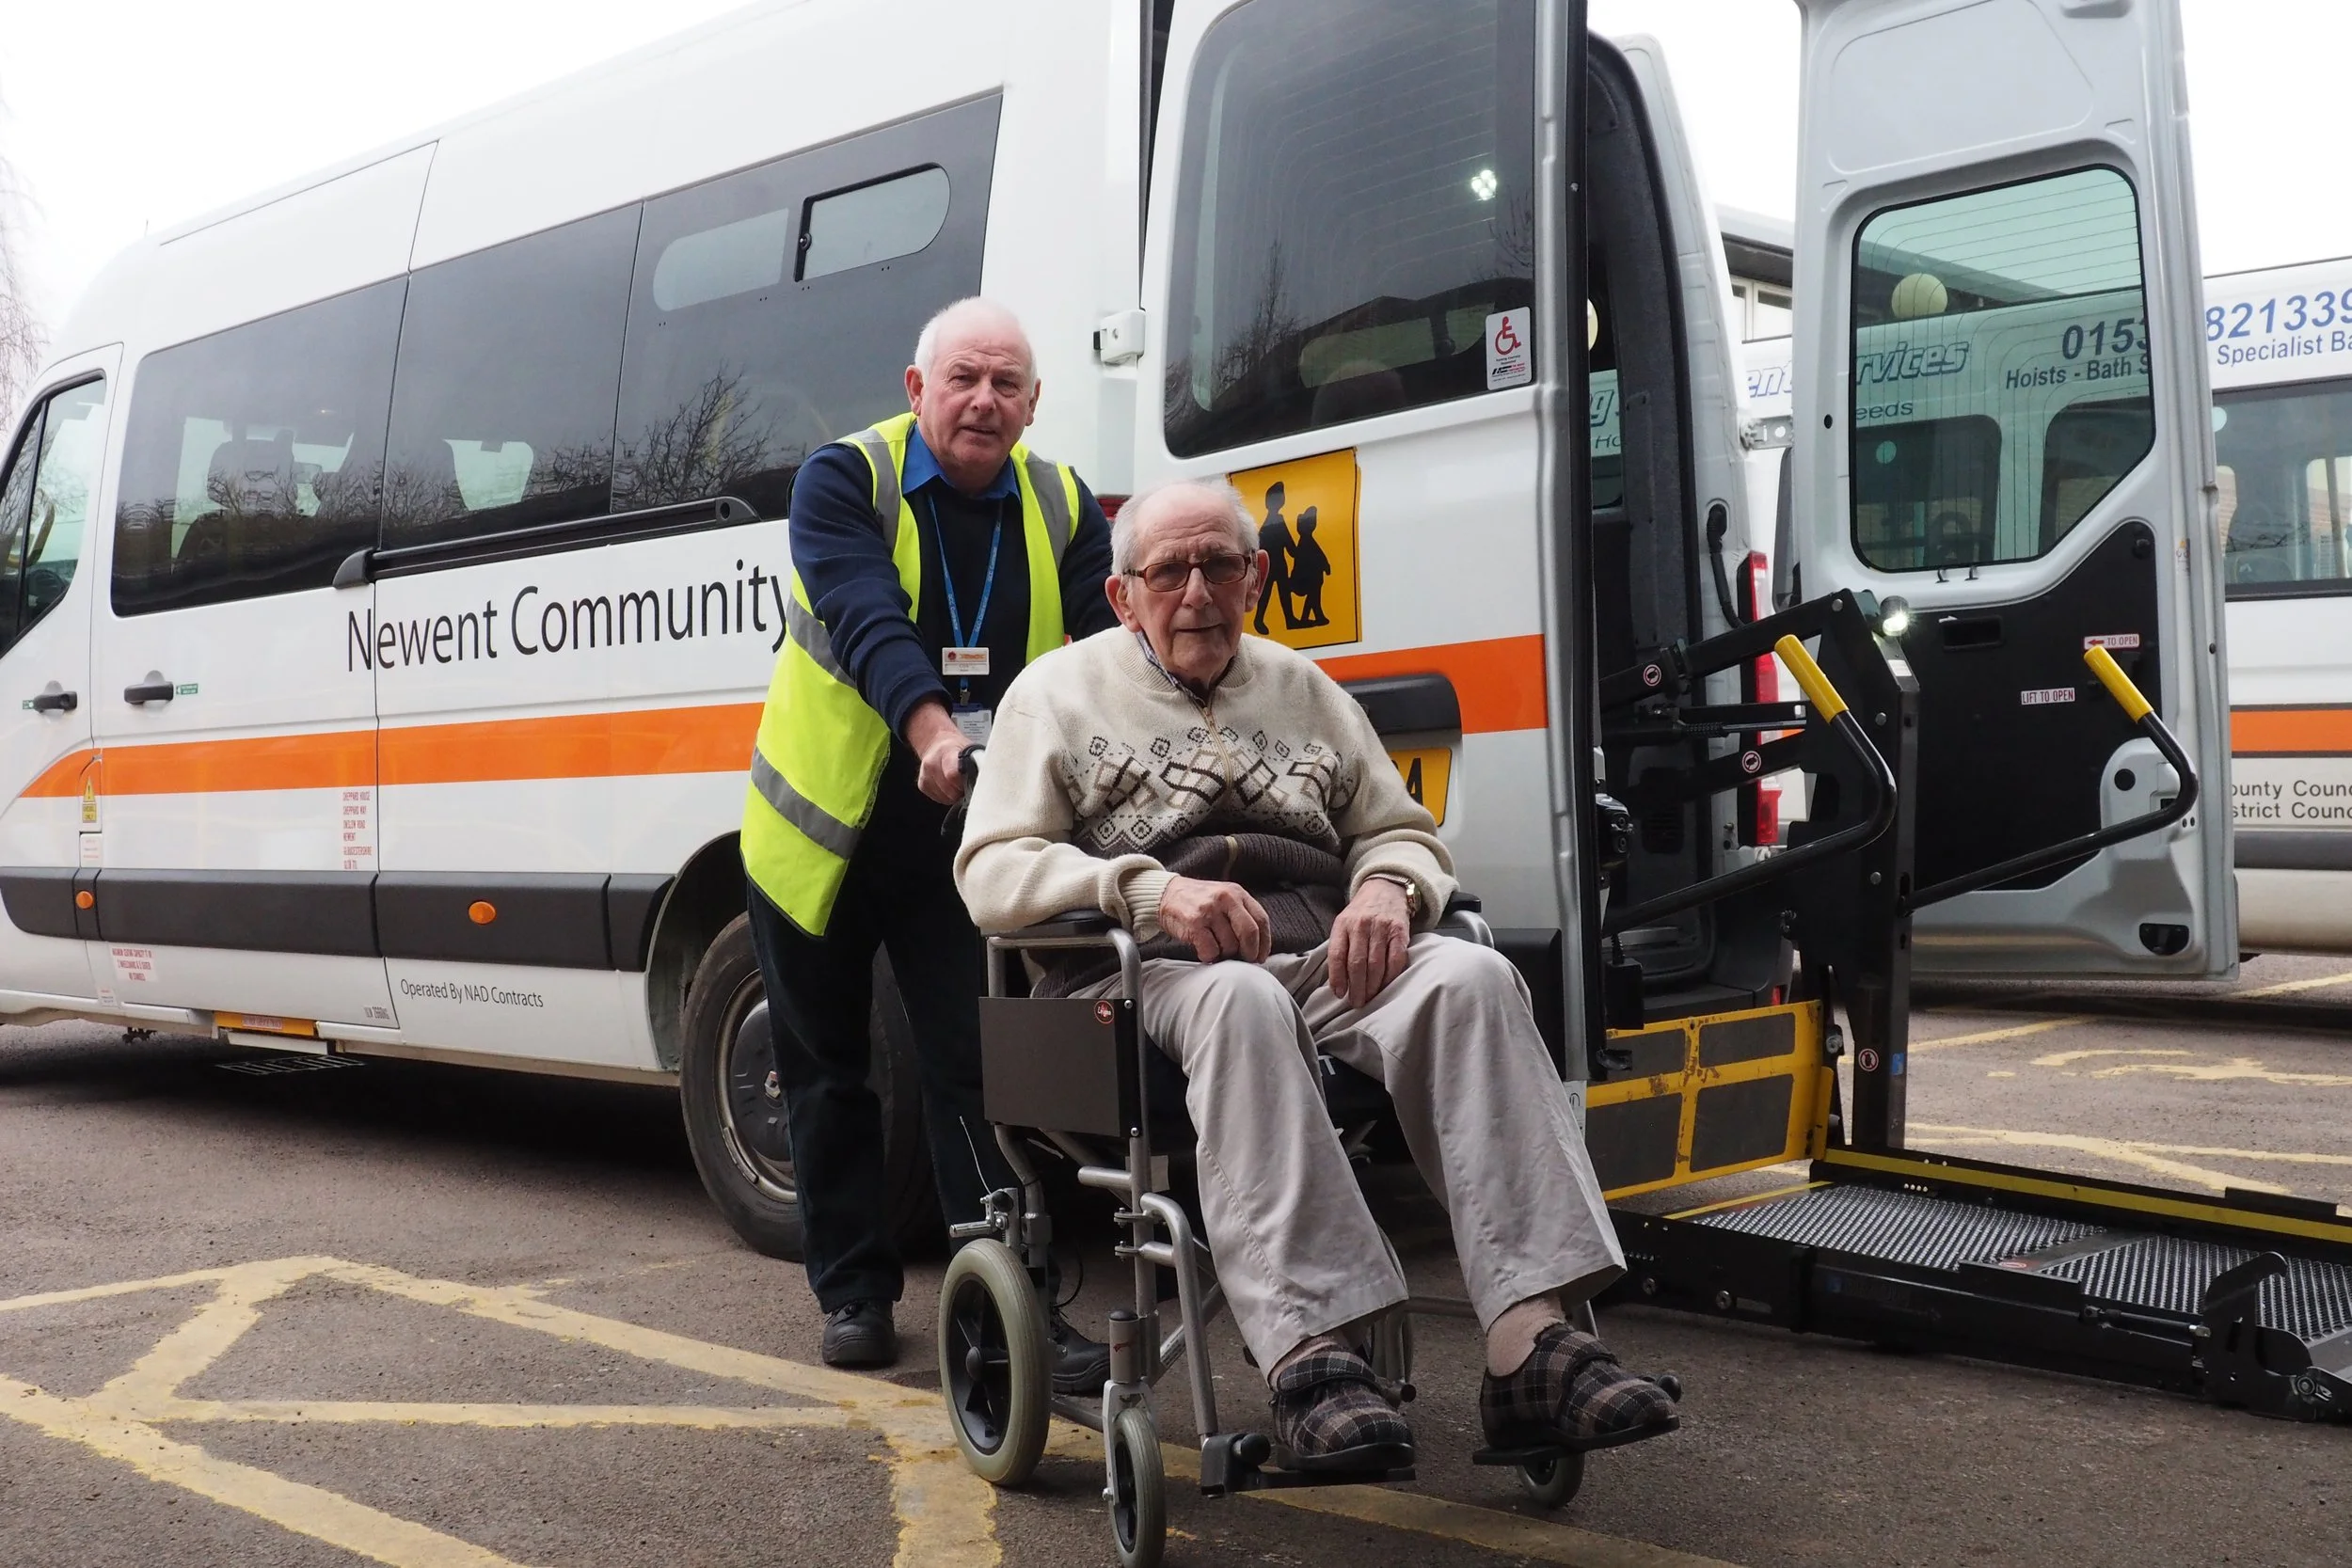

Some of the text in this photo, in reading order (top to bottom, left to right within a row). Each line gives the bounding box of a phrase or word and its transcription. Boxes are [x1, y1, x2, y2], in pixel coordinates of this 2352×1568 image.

[2006, 366, 2067, 389] Hoists
[2087, 356, 2132, 380] Bath
[2217, 334, 2323, 367] Specialist
[347, 599, 499, 673] Newent
[2119, 636, 2138, 646] OPEN
[2022, 689, 2074, 704] LIFT TO OPEN
[400, 978, 544, 1007] Operated By NAD Contracts
